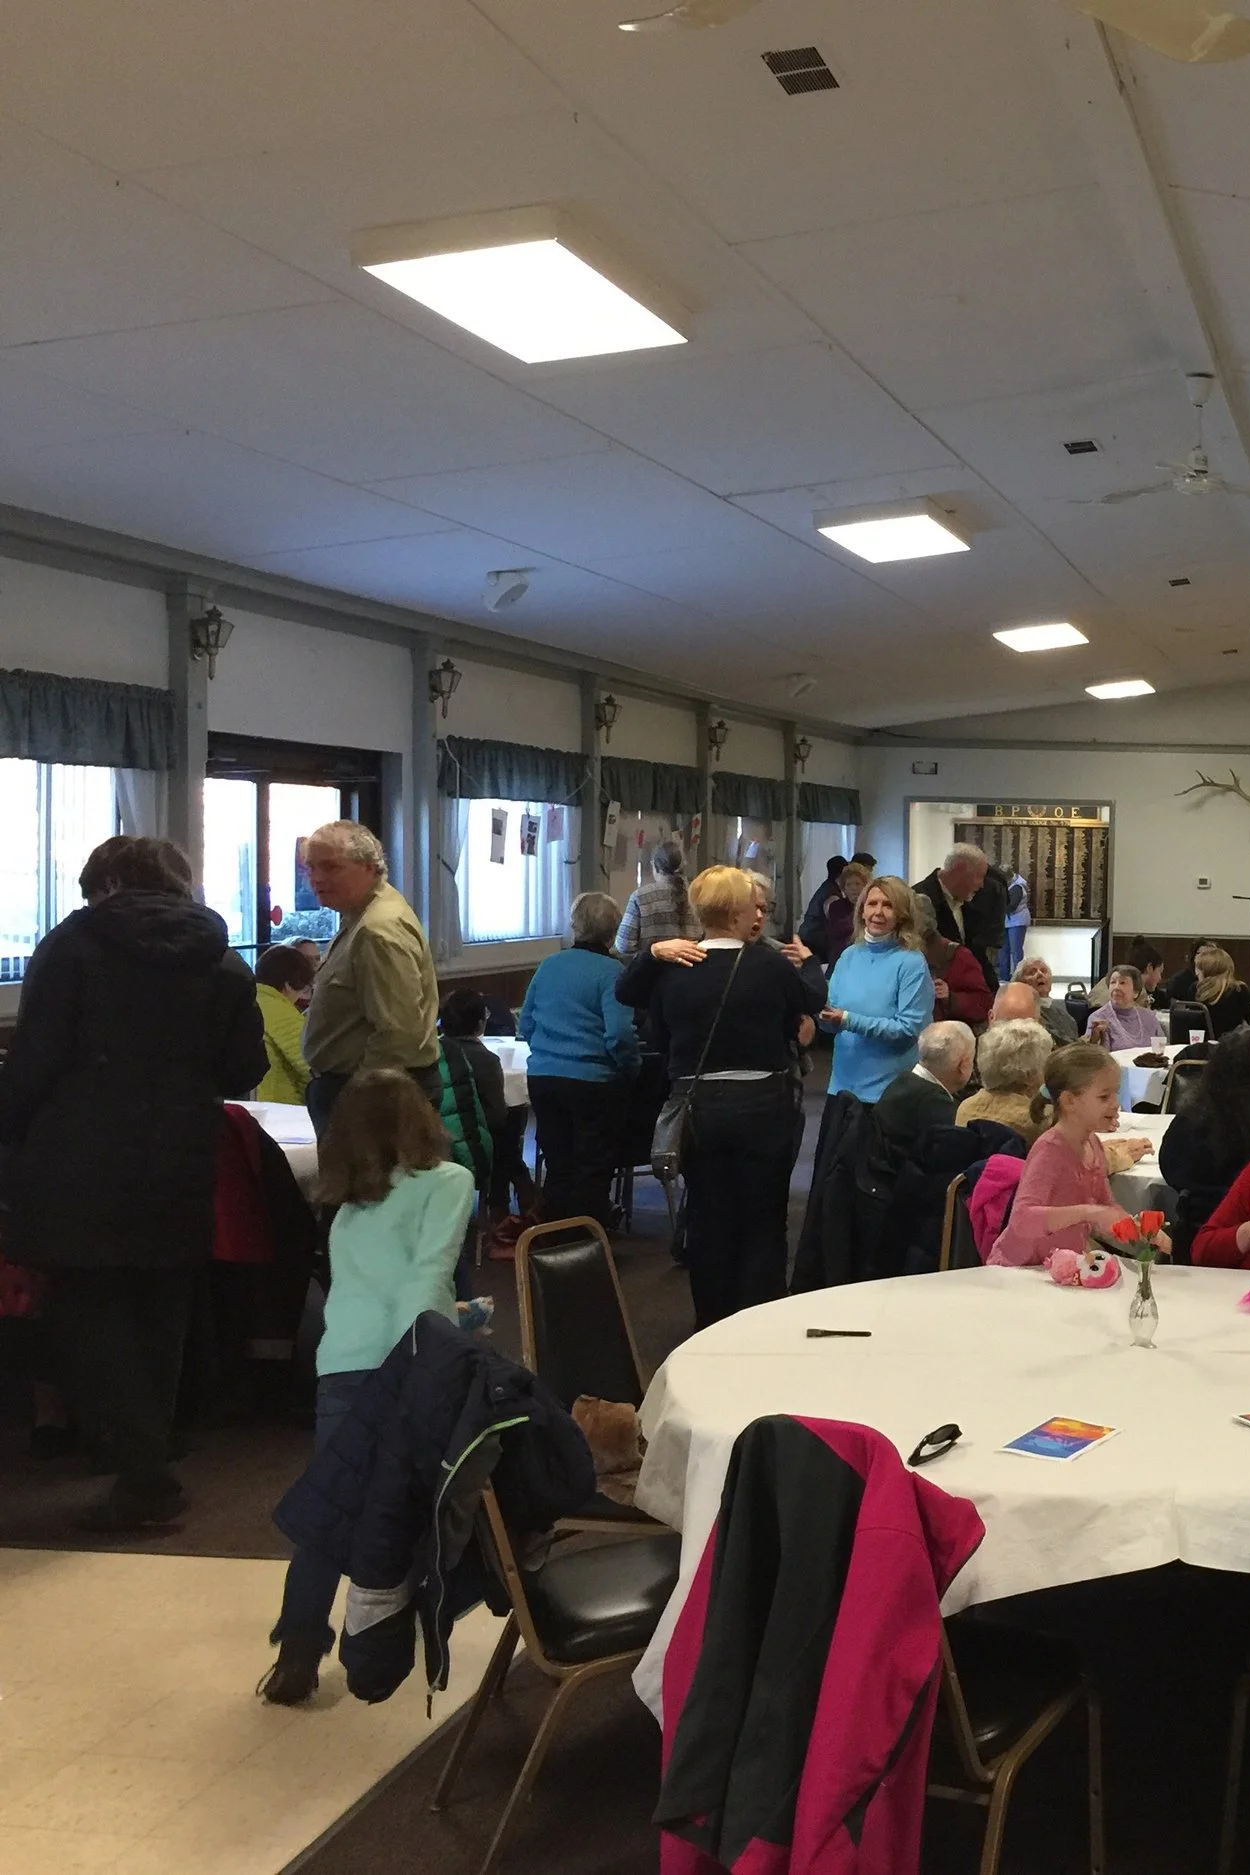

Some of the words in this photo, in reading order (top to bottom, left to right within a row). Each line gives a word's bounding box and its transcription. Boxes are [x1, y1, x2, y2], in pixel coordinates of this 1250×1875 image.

[994, 805, 1004, 817] B
[1011, 805, 1021, 817] P
[1054, 806, 1064, 818] O
[1071, 807, 1081, 818] E
